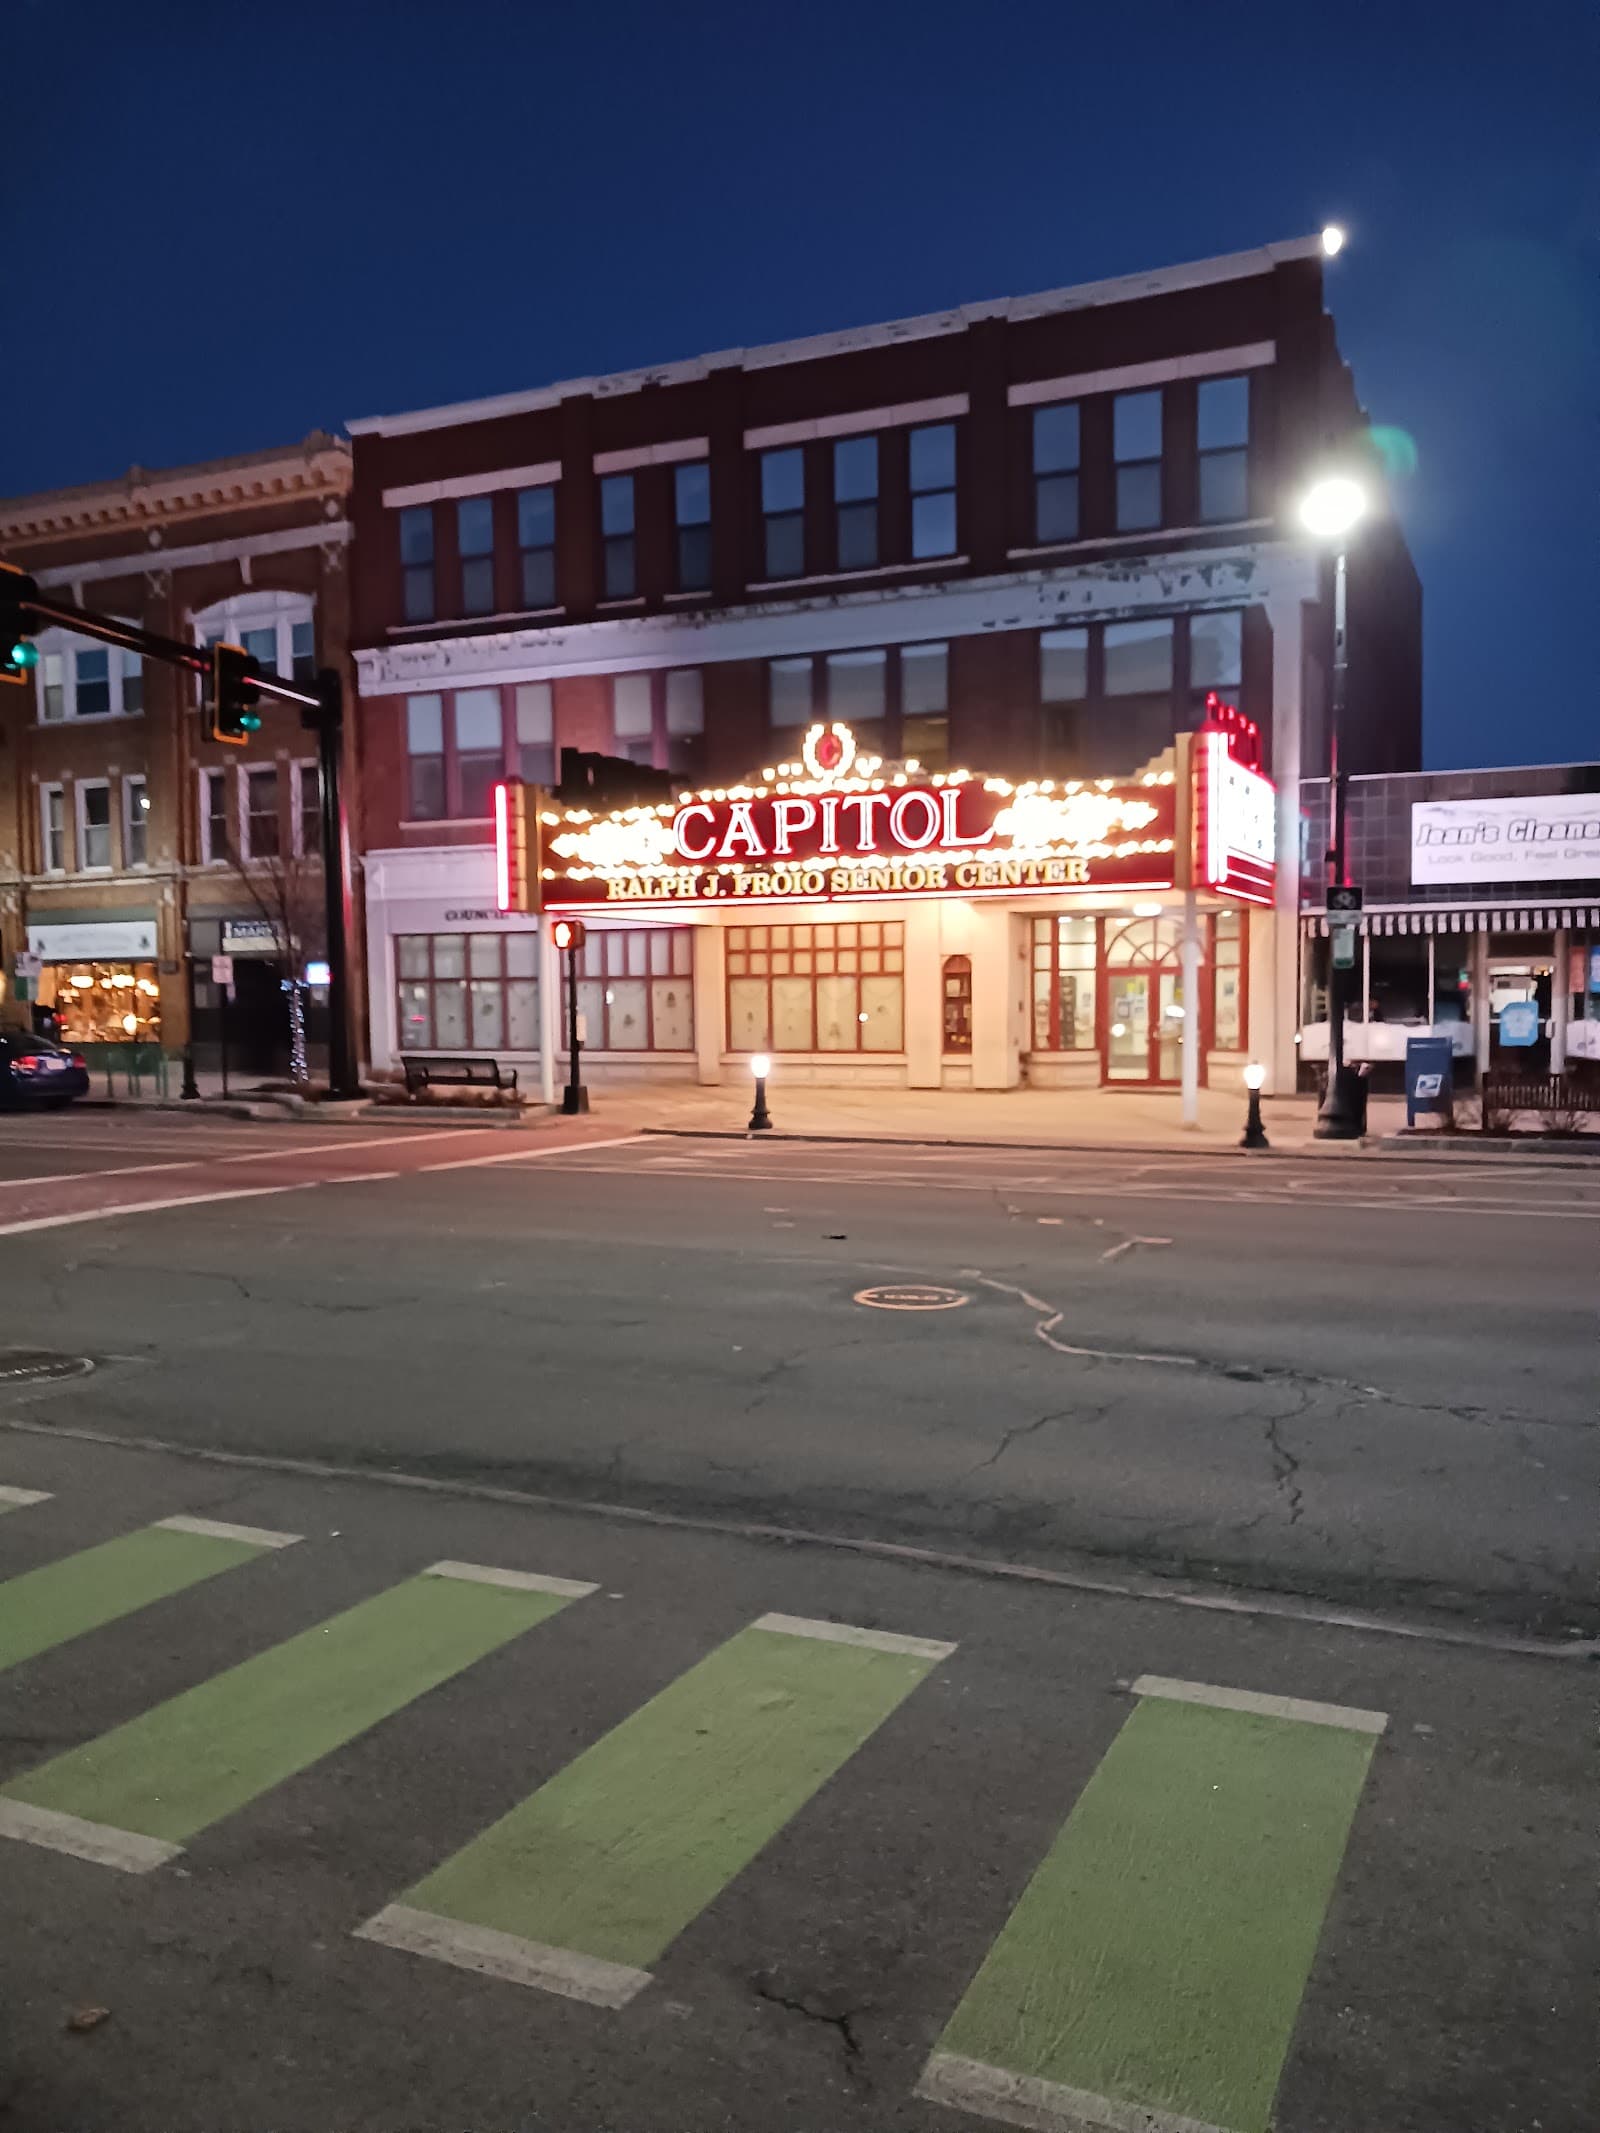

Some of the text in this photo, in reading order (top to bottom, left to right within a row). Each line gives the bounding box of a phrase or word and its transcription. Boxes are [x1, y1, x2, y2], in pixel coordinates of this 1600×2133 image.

[674, 788, 995, 859] CAPITOL
[606, 858, 1091, 900] RALPH J. FROIO SENIOR CENTER
